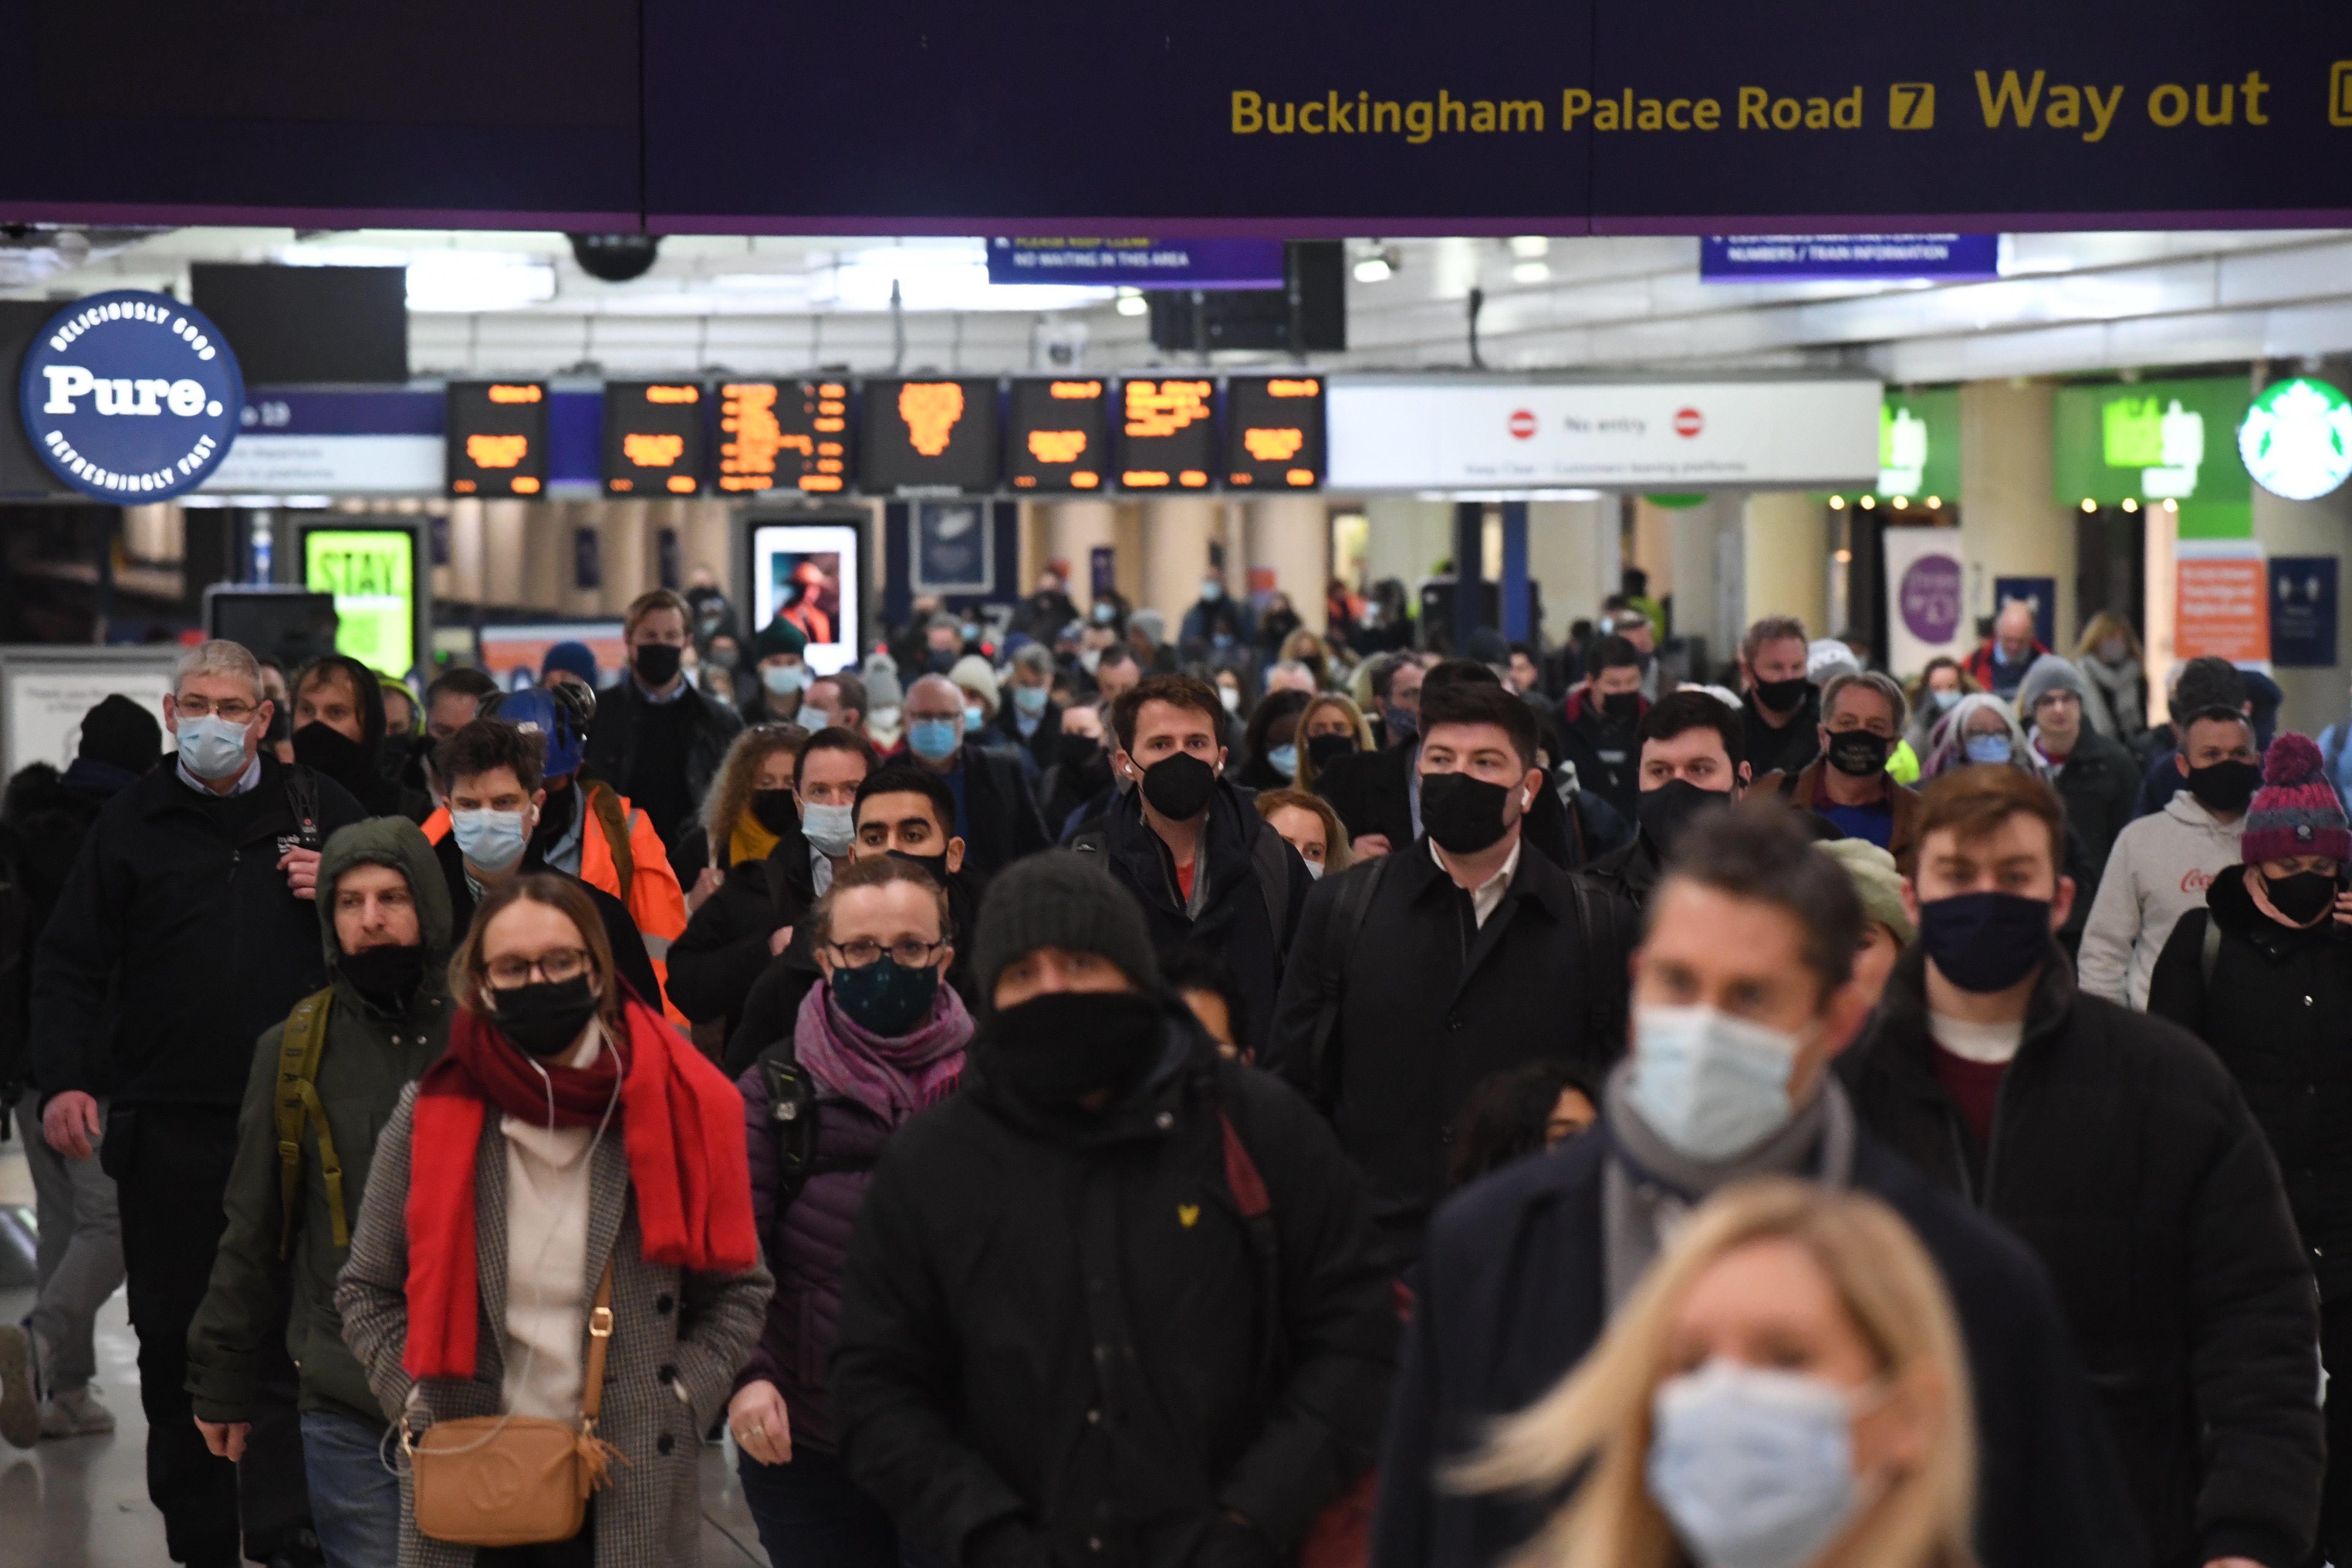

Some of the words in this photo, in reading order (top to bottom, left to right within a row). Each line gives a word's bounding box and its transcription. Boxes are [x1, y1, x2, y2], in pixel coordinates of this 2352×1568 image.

[1231, 89, 1545, 144] Buckingham
[1562, 87, 1721, 131] Palace
[1738, 85, 1863, 130] Road
[1897, 87, 1925, 125] 7
[1974, 69, 2124, 142] Way
[2148, 71, 2270, 127] out
[49, 301, 170, 352] DELICIOUSLY
[172, 317, 216, 361] GOOD
[43, 365, 223, 417] Pure.
[1598, 416, 1647, 438] entry
[44, 430, 174, 492] REFRESHINGLY
[177, 434, 217, 475] FAST
[319, 552, 397, 595] STAY
